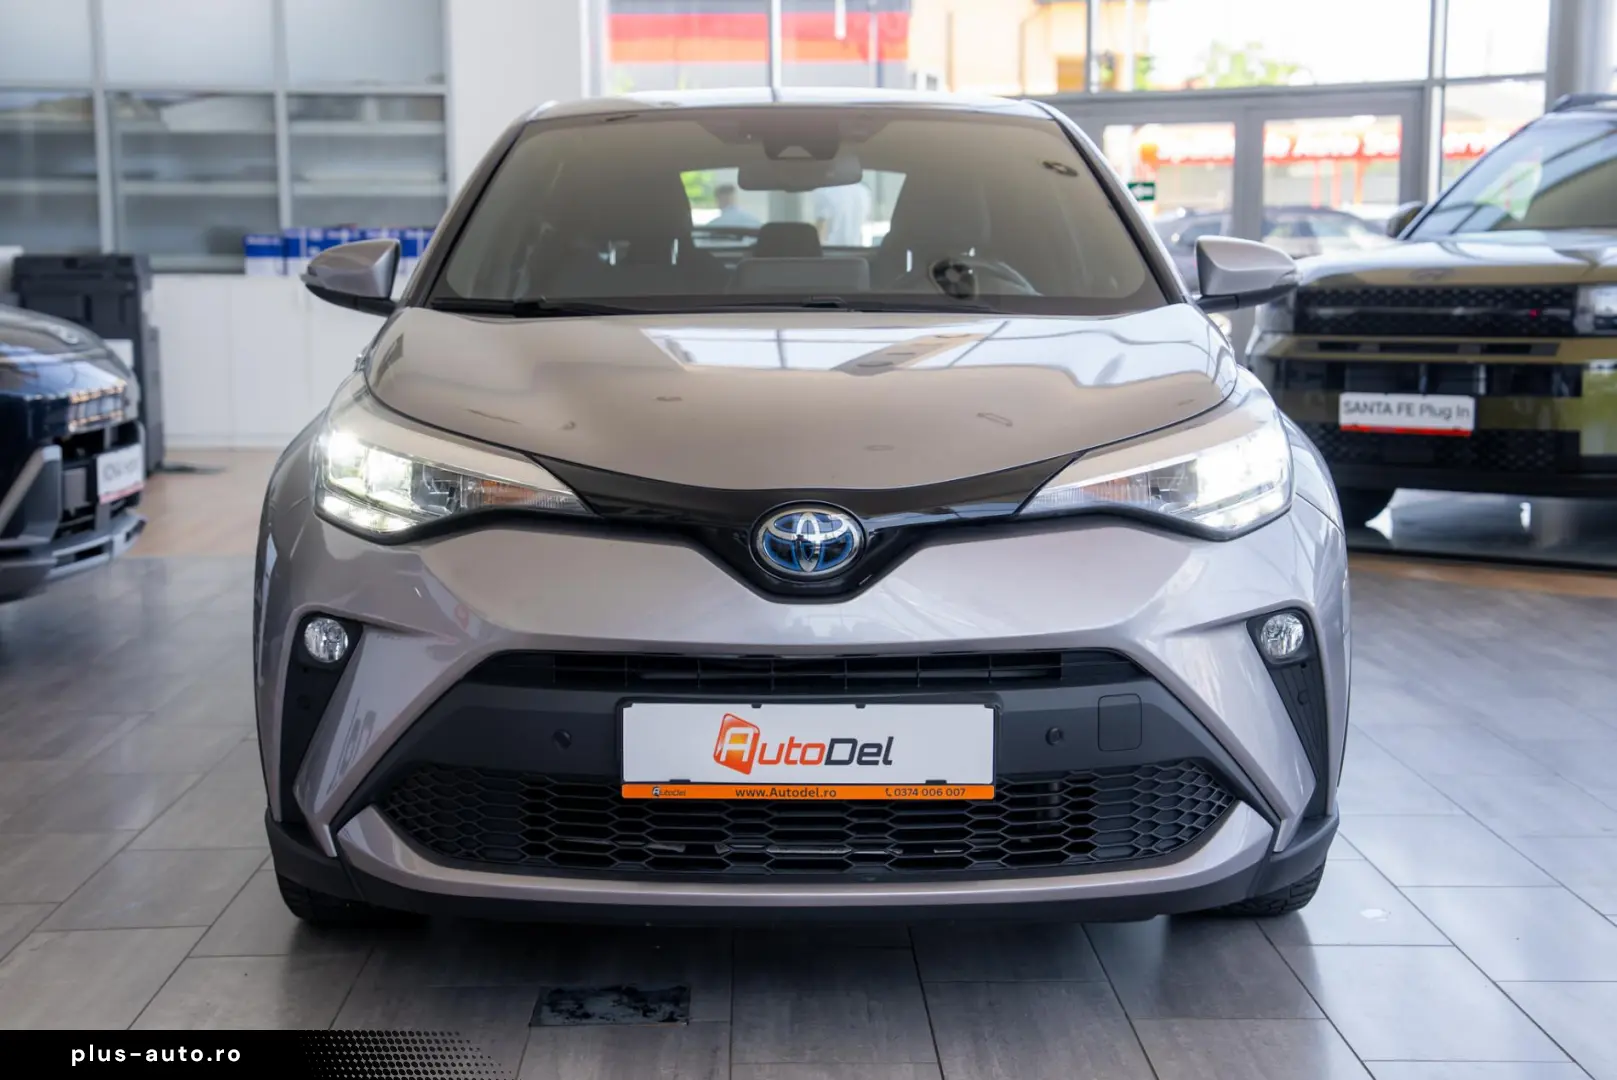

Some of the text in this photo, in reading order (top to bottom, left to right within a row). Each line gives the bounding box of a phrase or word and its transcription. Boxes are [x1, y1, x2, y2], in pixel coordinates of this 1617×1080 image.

[1343, 401, 1471, 421] SANTA FE Plug In
[717, 723, 894, 768] AutoDel
[735, 787, 837, 798] www.Autodel.ro
[893, 787, 966, 797] 0374 006 007
